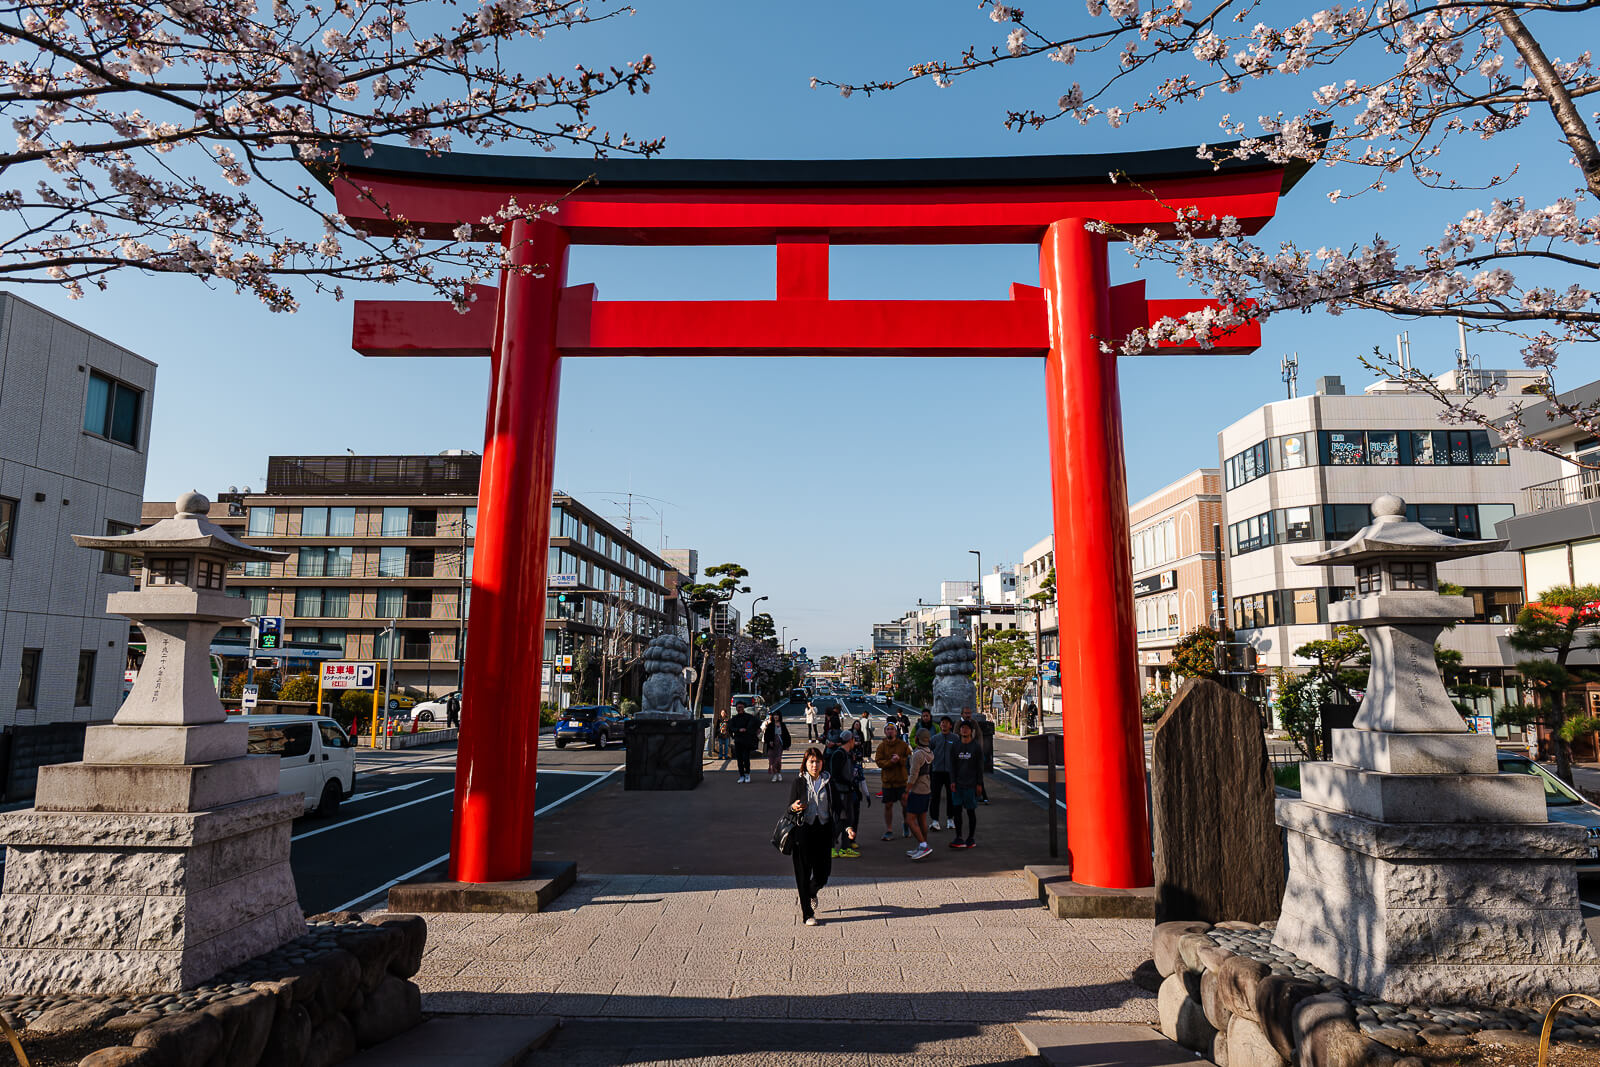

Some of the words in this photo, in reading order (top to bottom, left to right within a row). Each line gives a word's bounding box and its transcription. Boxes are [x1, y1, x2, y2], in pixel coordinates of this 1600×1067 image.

[263, 618, 277, 632] P
[262, 634, 276, 648] 空
[326, 664, 355, 675] 駐車場
[357, 666, 373, 686] P
